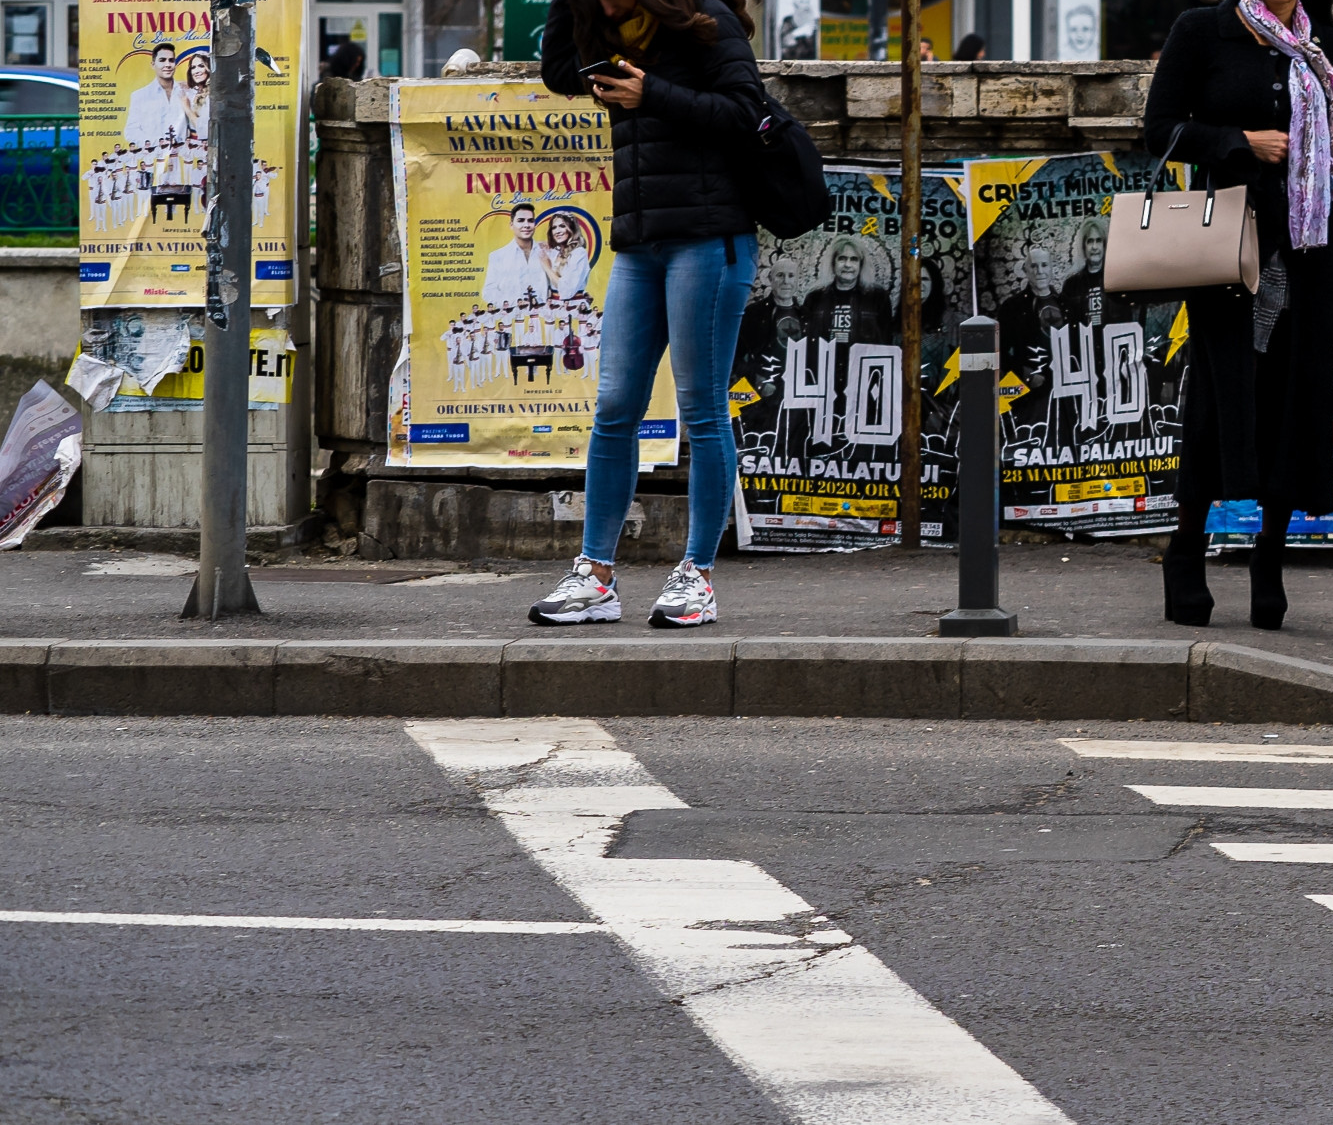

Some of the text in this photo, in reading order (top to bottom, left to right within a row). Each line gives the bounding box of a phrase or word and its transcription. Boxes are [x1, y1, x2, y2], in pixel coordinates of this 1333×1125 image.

[107, 11, 211, 34] INIMIOA
[445, 112, 613, 132] LAVINIA GOST
[449, 134, 613, 152] MARIUS ZORIL
[466, 167, 612, 194] INIMIOARĂ
[978, 181, 1055, 203] CRISTI
[1018, 198, 1097, 221] VALTER
[1049, 321, 1147, 432] 40
[781, 336, 903, 447] 40
[437, 401, 590, 416] ORCHESTRA NAȚIONALĂ
[1013, 436, 1174, 467] SALA PALATULUI
[741, 455, 802, 476] SALA
[1003, 470, 1023, 483] 28
[1026, 466, 1084, 482] MARTIE
[1120, 461, 1145, 476] ORA
[1149, 456, 1180, 472] 19:30
[753, 477, 816, 492] MARTIE
[865, 483, 900, 499] ORA
